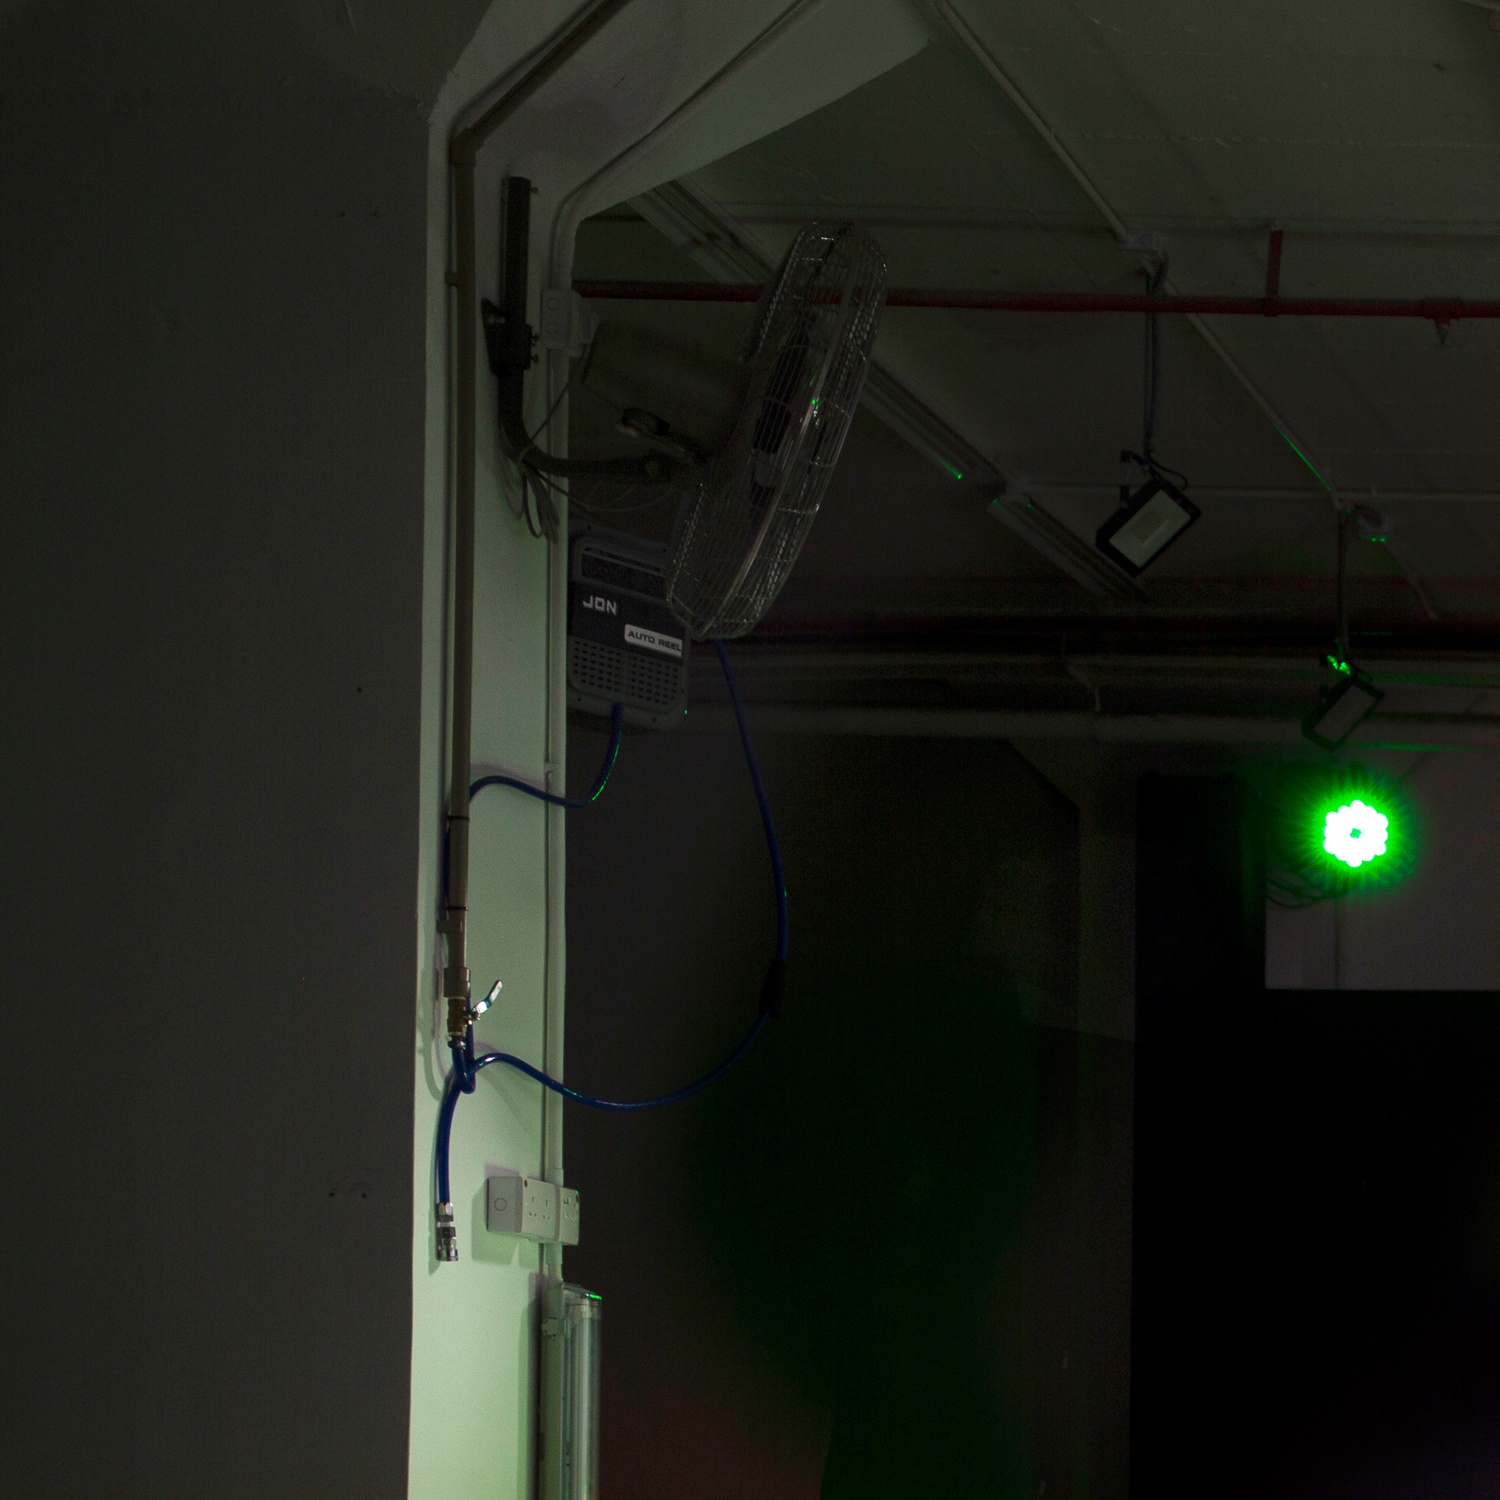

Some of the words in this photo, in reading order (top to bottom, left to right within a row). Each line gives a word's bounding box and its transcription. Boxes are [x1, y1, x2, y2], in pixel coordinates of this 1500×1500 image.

[582, 594, 617, 615] JON
[628, 630, 655, 643] AUTO
[659, 639, 682, 651] REEL
